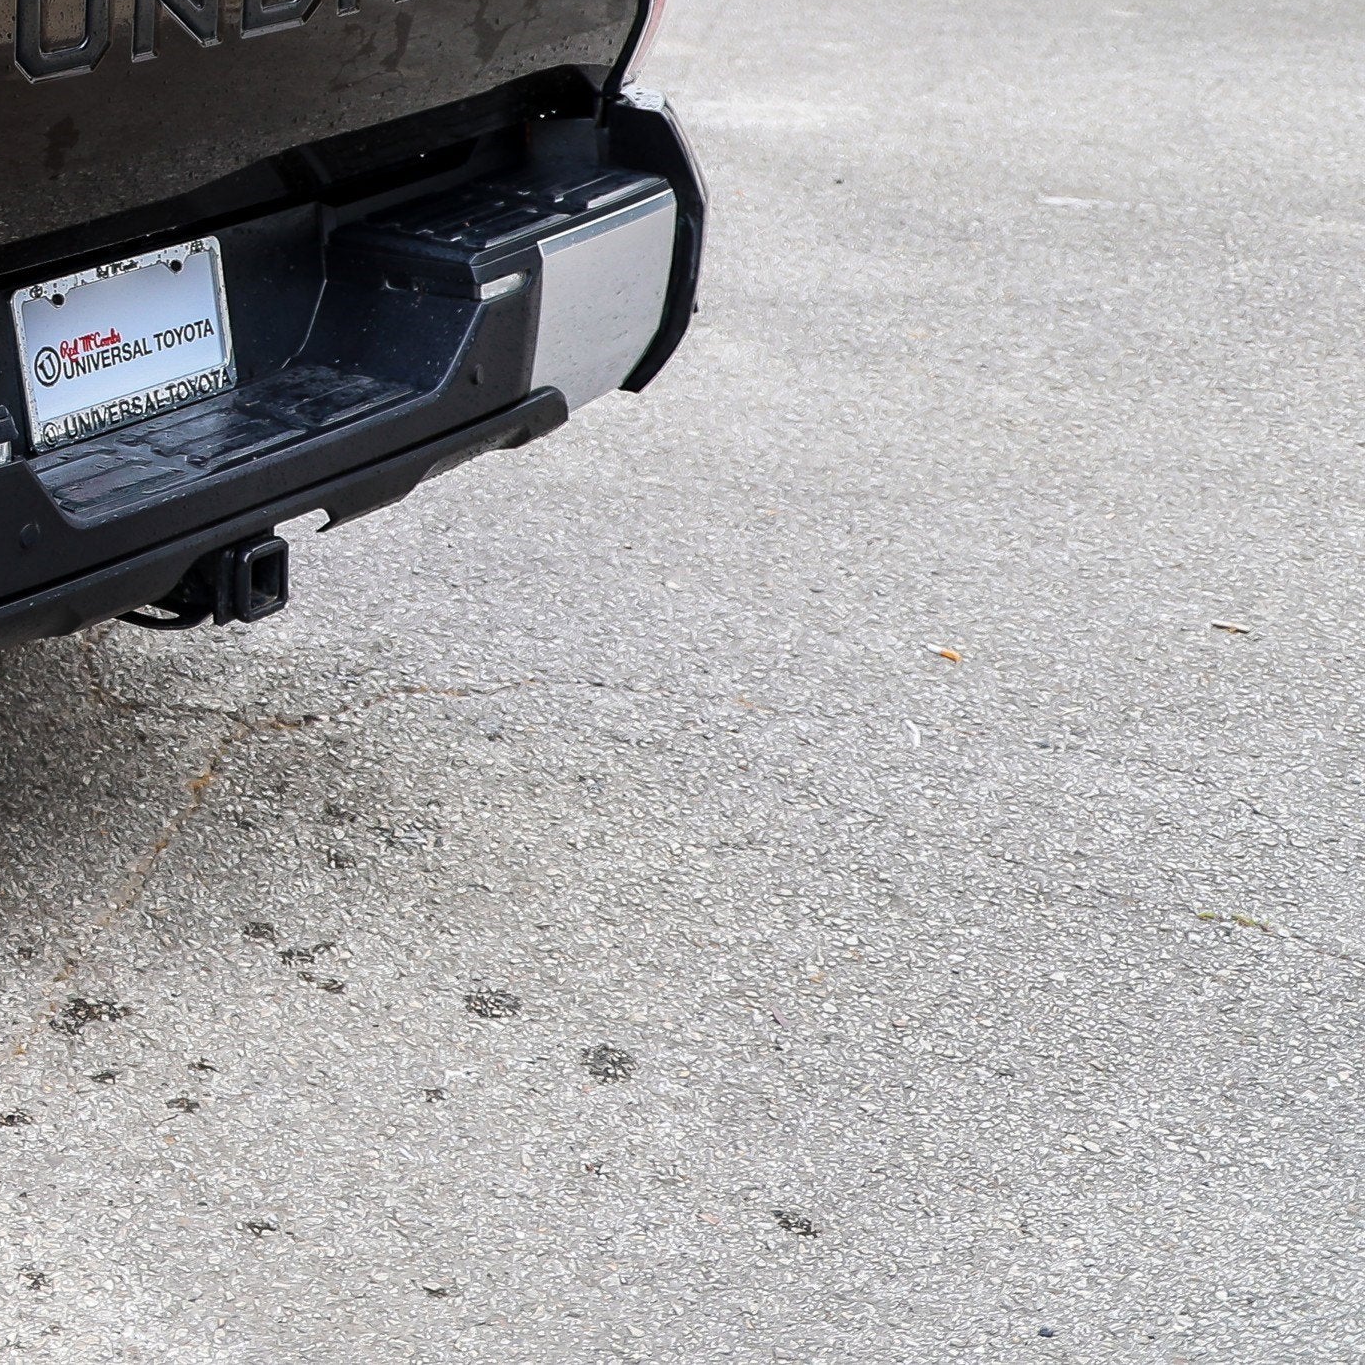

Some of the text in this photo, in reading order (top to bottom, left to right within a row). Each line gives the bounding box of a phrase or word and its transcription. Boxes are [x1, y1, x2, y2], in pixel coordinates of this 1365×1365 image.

[60, 339, 80, 363] Red
[63, 318, 215, 380] UNIVERSAL TOYOTA
[63, 389, 168, 439] UNIVERSAL
[165, 367, 232, 405] TOYOTA
